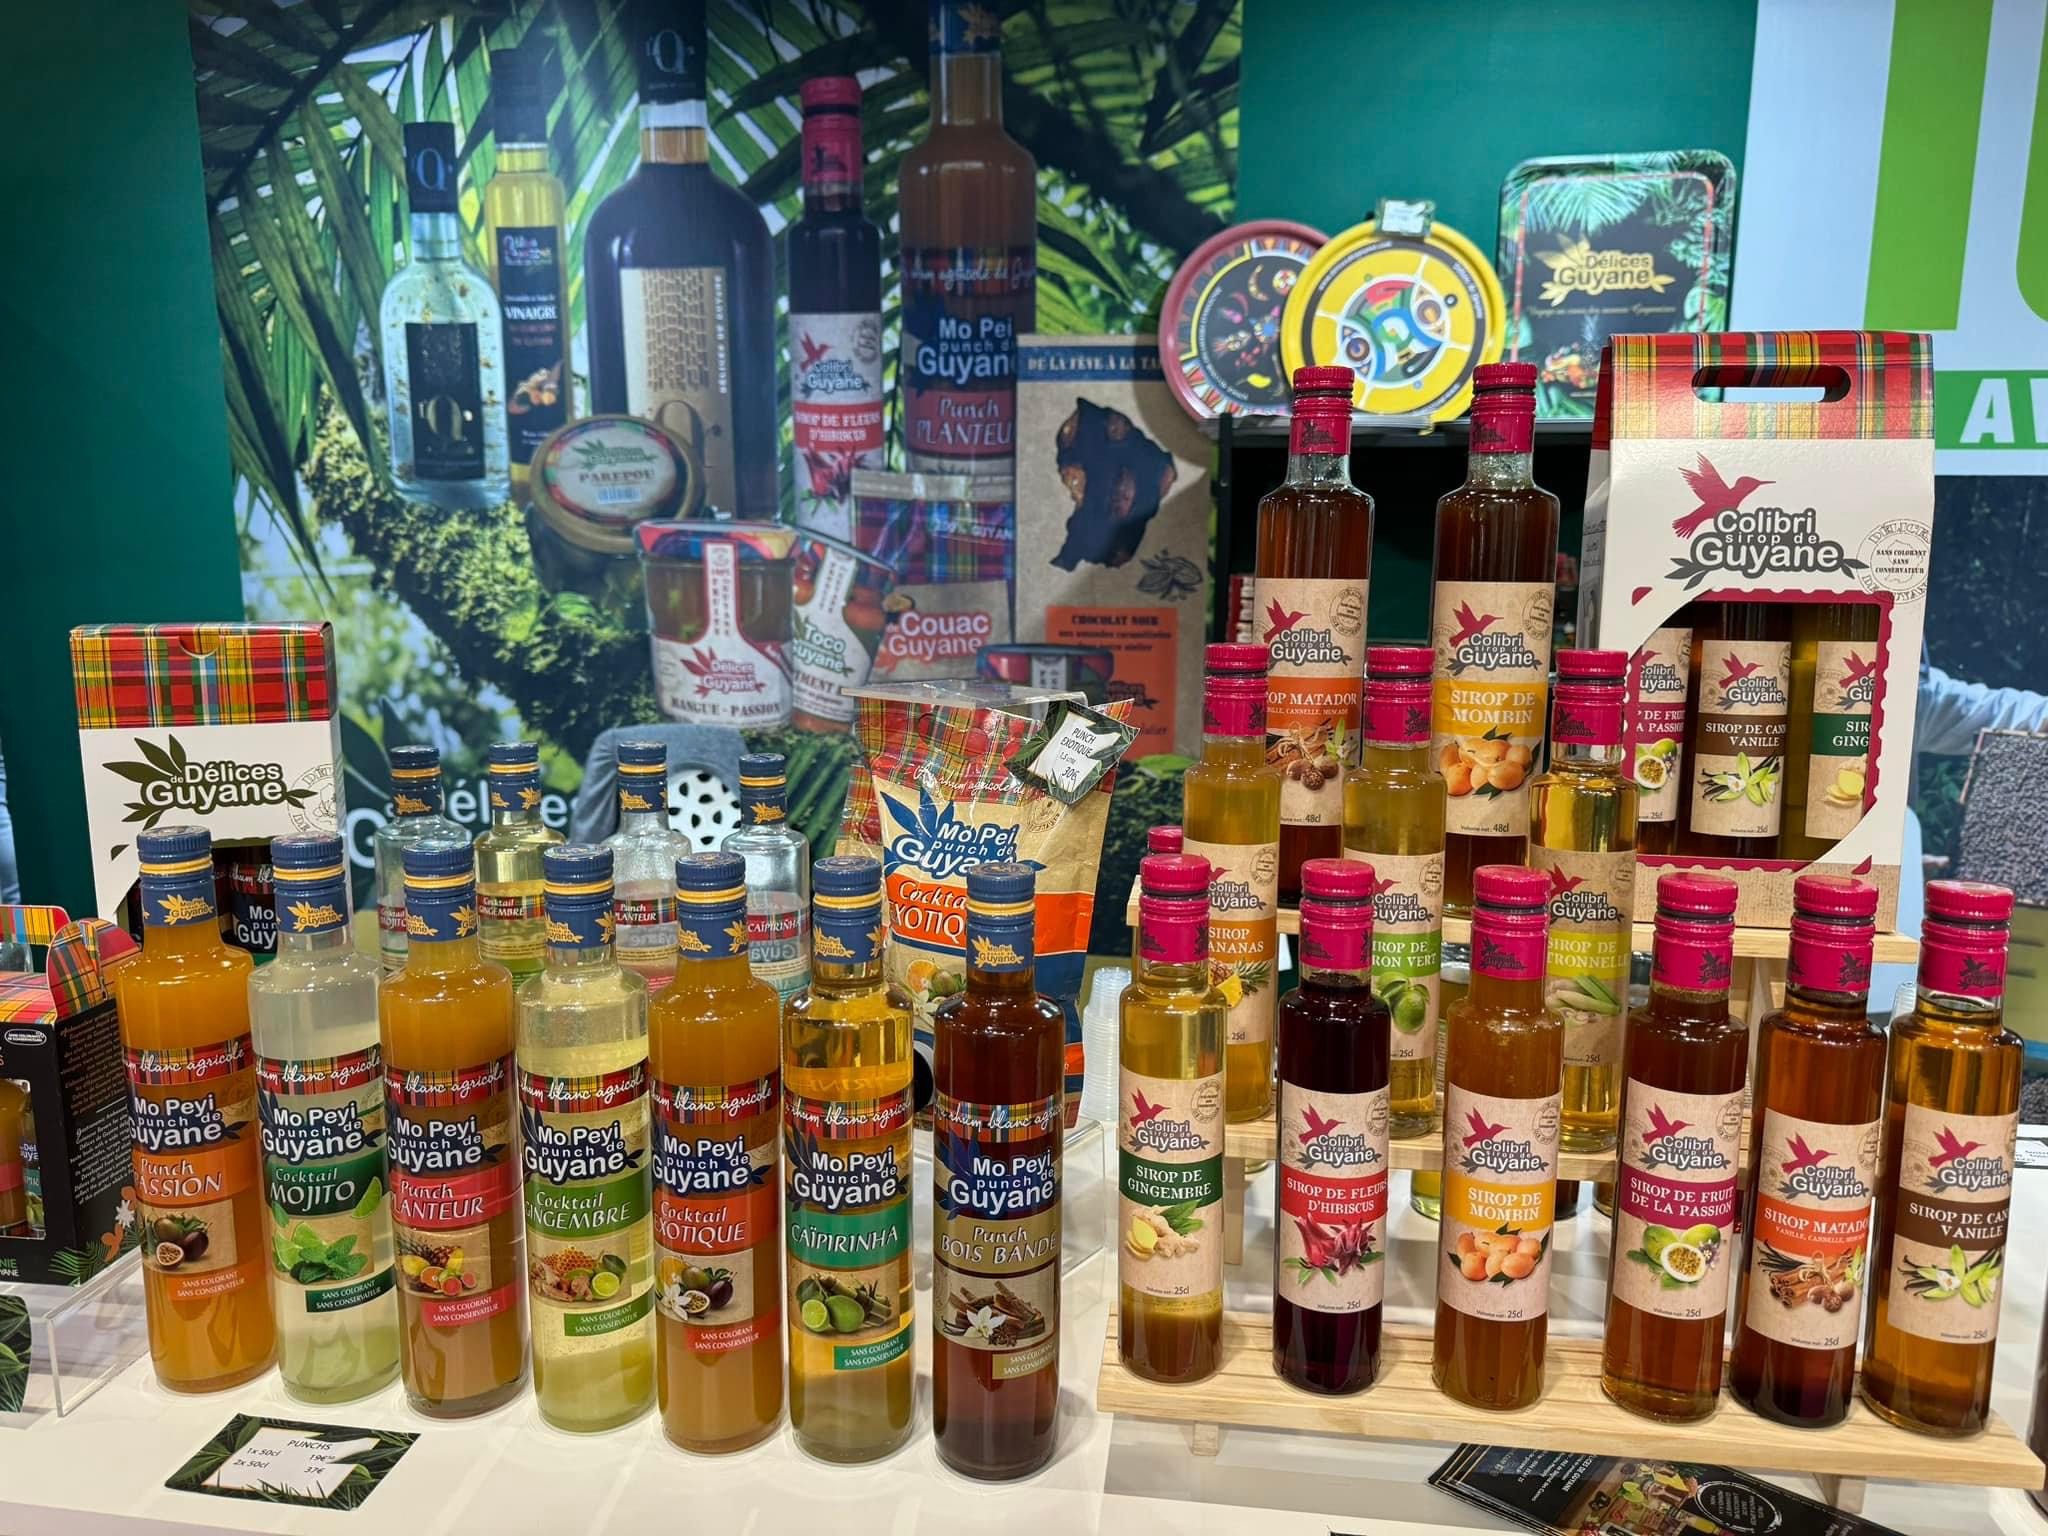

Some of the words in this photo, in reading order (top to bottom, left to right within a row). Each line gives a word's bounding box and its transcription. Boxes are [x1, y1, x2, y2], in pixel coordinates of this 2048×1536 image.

[1585, 255, 1650, 268] Délices
[939, 318, 972, 340] Mo
[980, 316, 1012, 339] Pei
[917, 347, 1012, 384] Guyan
[807, 374, 863, 390] Guyane
[939, 398, 999, 419] Punch
[917, 420, 1013, 445] PLANTEU
[1717, 510, 1813, 534] Colibri
[1725, 533, 1781, 546] sirop
[1695, 536, 1839, 572] Guyane
[901, 612, 989, 635] Couac
[804, 623, 845, 653] Toco
[1280, 629, 1331, 643] Colibri
[888, 634, 982, 658] Guyane
[1271, 644, 1341, 664] Guyane
[703, 674, 756, 690] Guyane
[1290, 692, 1357, 705] MATADOR
[1450, 690, 1508, 705] SIROP
[1513, 692, 1535, 705] DE
[1451, 708, 1533, 724] MOMBIN
[1072, 727, 1097, 744] PUNCH
[1705, 723, 1742, 734] SIROP
[1746, 724, 1763, 734] DE
[1060, 736, 1094, 757] EXOTIQUE
[1730, 736, 1780, 747] VANILLE
[170, 774, 184, 784] de
[184, 763, 281, 784] Délices
[145, 780, 283, 809] Guyane
[900, 881, 966, 909] Cockta
[1212, 897, 1258, 909] uyane
[1598, 940, 1617, 953] DE
[1407, 953, 1437, 967] VERT
[140, 1050, 181, 1073] blanc
[187, 1040, 244, 1077] agricole
[283, 1063, 325, 1082] blanc
[451, 1063, 505, 1099] agricole
[548, 1076, 591, 1100] blanc
[134, 1098, 159, 1117] Mo
[166, 1094, 214, 1117] Peyi
[674, 1086, 715, 1111] blanc
[721, 1080, 772, 1118] agricole
[139, 1116, 188, 1128] punch
[201, 1111, 221, 1123] de
[273, 1108, 301, 1127] Mo
[309, 1103, 357, 1130] Peyi
[824, 1103, 867, 1126] blanc
[988, 1107, 1031, 1129] blanc
[278, 1126, 331, 1138] punch
[343, 1120, 361, 1132] de
[396, 1117, 423, 1138] Mo
[429, 1116, 477, 1142] Peyi
[537, 1126, 566, 1146] Mo
[574, 1121, 620, 1147] Peyi
[1145, 1119, 1189, 1132] Colibri
[262, 1128, 362, 1162] Guyane
[400, 1139, 450, 1149] punch
[463, 1133, 482, 1146] de
[541, 1146, 594, 1157] punch
[606, 1140, 624, 1152] de
[664, 1136, 691, 1157] Mo
[698, 1136, 743, 1160] Peyi
[1318, 1135, 1364, 1147] Colibri
[1481, 1138, 1531, 1153] Colibri
[1663, 1135, 1713, 1150] Colibri
[141, 1157, 194, 1176] Punch
[524, 1146, 624, 1182] Guyane
[667, 1157, 718, 1169] punch
[730, 1154, 748, 1167] de
[812, 1152, 841, 1172] Mo
[849, 1147, 893, 1173] Peyi
[973, 1157, 1005, 1177] Mo
[1013, 1151, 1051, 1176] Peyi
[1953, 1157, 2002, 1171] Colibri
[275, 1167, 338, 1183] Cocktail
[652, 1155, 749, 1193] Guyane
[815, 1173, 870, 1184] punch
[881, 1166, 897, 1178] de
[976, 1177, 1031, 1189] punch
[1041, 1168, 1054, 1181] de
[1136, 1164, 1178, 1183] SIROP
[1182, 1169, 1202, 1182] DE
[1804, 1165, 1855, 1180] Colibri
[270, 1180, 355, 1211] MOJITO
[400, 1180, 453, 1199] Punch
[794, 1172, 897, 1210] Guyane
[951, 1178, 1054, 1215] Guyane
[1128, 1177, 1211, 1199] GINGEMBRE
[1326, 1187, 1347, 1199] DE
[1468, 1187, 1517, 1206] SIROP
[1521, 1192, 1542, 1206] DE
[1630, 1177, 1671, 1201] SIROP
[1674, 1190, 1696, 1203] DE
[536, 1191, 603, 1210] Cocktail
[1308, 1200, 1375, 1214] D'HIBISCUS
[1631, 1191, 1649, 1207] DE
[1653, 1199, 1674, 1215] LA
[1679, 1201, 1732, 1217] PASSION
[661, 1201, 727, 1223] Cocktail
[1470, 1203, 1540, 1222] MOMBIN
[1764, 1206, 1810, 1230] SIROP
[1813, 1220, 1868, 1234] MATADO
[1909, 1202, 1958, 1223] SIROP
[1961, 1213, 1983, 1225] DE
[791, 1223, 899, 1253] CAÏPIRINHA
[972, 1226, 1027, 1243] Punch
[1941, 1224, 2004, 1239] VANILLE
[941, 1234, 983, 1264] BOIS
[1174, 1286, 1189, 1295] 25cl
[438, 1304, 456, 1312] SANS
[1346, 1301, 1361, 1310] 25cl
[1507, 1309, 1523, 1319] 25cl
[1685, 1308, 1701, 1317] 25cl
[433, 1314, 451, 1322] SANS
[1823, 1336, 1839, 1346] 25cl
[260, 1448, 281, 1458] 50cl
[287, 1439, 332, 1450] PUNCHS
[247, 1460, 269, 1469] 50cl
[304, 1466, 324, 1475] 37€
